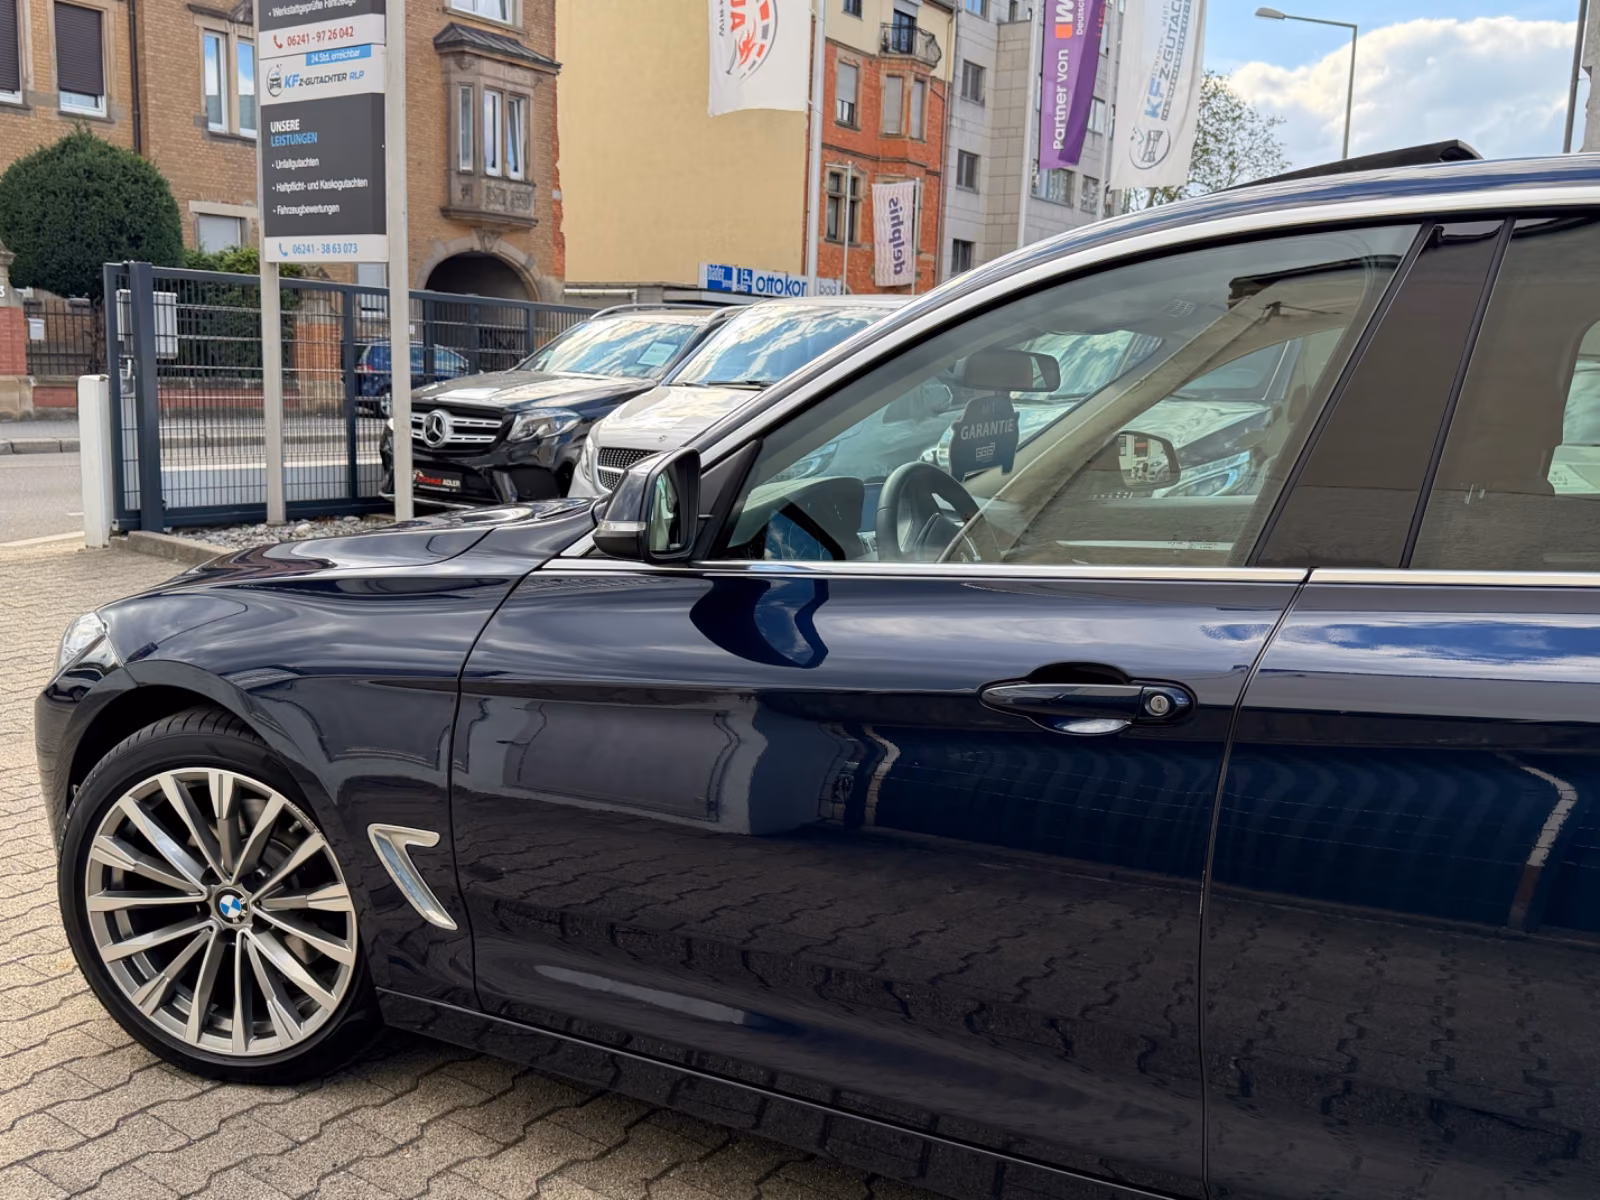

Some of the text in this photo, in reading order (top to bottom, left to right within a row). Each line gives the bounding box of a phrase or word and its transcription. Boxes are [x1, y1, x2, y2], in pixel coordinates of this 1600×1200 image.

[287, 33, 310, 46] 06241
[316, 31, 326, 42] 97
[328, 29, 338, 40] 26
[339, 26, 354, 38] 042
[349, 70, 364, 82] RLP
[1053, 49, 1069, 150] Partner von
[270, 119, 300, 133] UNSERE
[271, 132, 318, 147] LEISTUNGEN
[275, 157, 319, 170] Unfallgutachten
[307, 181, 318, 190] und
[320, 178, 368, 191] Kaskogutachten
[277, 204, 340, 217] Fahrzeugbewertungen
[292, 243, 314, 254] 06241
[321, 243, 331, 254] 38
[332, 243, 342, 254] 63
[343, 242, 358, 254] 073
[961, 419, 1015, 440] GARANTIE
